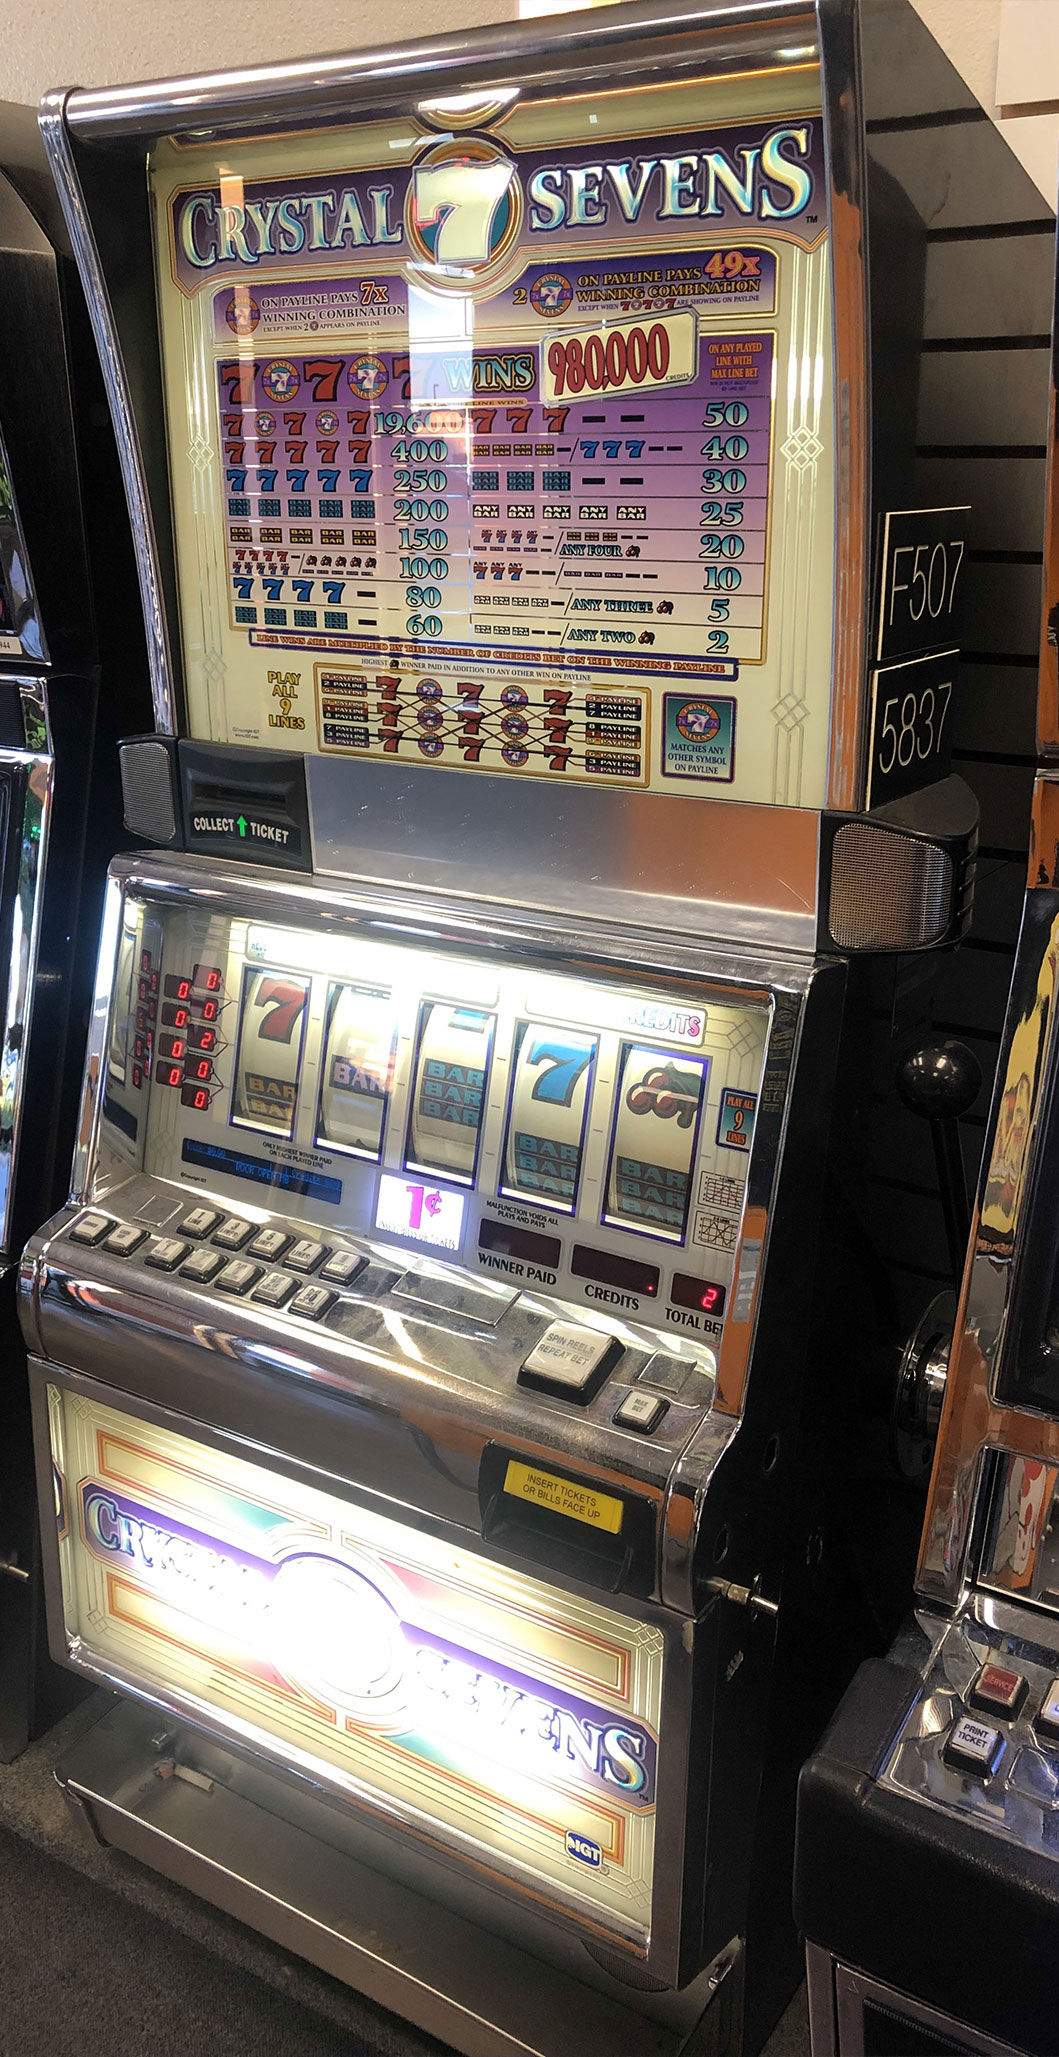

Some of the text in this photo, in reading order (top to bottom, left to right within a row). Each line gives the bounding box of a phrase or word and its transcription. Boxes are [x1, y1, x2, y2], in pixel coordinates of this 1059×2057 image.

[181, 188, 402, 268] CRYSTAL
[531, 129, 810, 230] SEVENS
[512, 288, 527, 305] 2
[578, 274, 600, 287] ON
[604, 271, 662, 285] PAYLINE
[667, 268, 701, 281] PAYS
[577, 280, 760, 302] WINNING COMBINATION
[262, 298, 278, 308] ON
[282, 294, 327, 307] PAYLINE
[331, 292, 358, 303] PAYS
[690, 297, 721, 305] SHOWING
[263, 305, 405, 322] WINNING COMBINATION
[444, 356, 534, 391] WINS
[549, 323, 670, 395] 980,000
[709, 343, 762, 354] ON ANY PLAYED
[716, 356, 752, 365] LINE WITH
[712, 368, 758, 378] MAX LINE BET
[374, 411, 464, 434] 19,600
[703, 402, 749, 427] 50
[391, 440, 448, 462] 400
[701, 436, 749, 460] 40
[393, 470, 447, 492] 250
[701, 469, 746, 494] 30
[393, 499, 448, 521] 200
[700, 502, 744, 526] 25
[399, 528, 448, 550] 150
[699, 534, 744, 559] 20
[561, 544, 622, 557] ANY FOUR
[400, 557, 448, 580] 100
[703, 566, 742, 591] 10
[889, 540, 965, 626] F507
[406, 586, 441, 608] 80
[571, 599, 653, 613] ANY THREE
[707, 599, 730, 622] 5
[406, 614, 442, 637] 60
[567, 629, 636, 644] ANY TWO
[706, 630, 729, 654] 2
[257, 634, 278, 643] LINE
[280, 636, 306, 644] WINS
[307, 638, 326, 646] ARE
[390, 643, 403, 651] BY
[404, 645, 425, 653] THE
[428, 646, 475, 657] NUMBER
[476, 650, 492, 658] OF
[567, 656, 585, 664] ON
[588, 657, 612, 666] THE
[614, 659, 671, 670] WINNING
[673, 662, 725, 673] PAYLINE
[267, 671, 301, 685] PLAY
[361, 658, 388, 666] HIGHEST
[401, 662, 426, 670] WINNER
[452, 665, 485, 673] ADDITION
[512, 669, 534, 678] OTHER
[536, 671, 550, 679] WIN
[564, 673, 591, 681] PAYLINE
[272, 685, 298, 698] ALL
[280, 698, 291, 715] 9
[601, 704, 637, 712] PAYLINE
[268, 714, 305, 730] LINES
[879, 681, 952, 774] 5837
[668, 753, 727, 765] OTHER SYMBOL
[671, 743, 724, 755] MATCHES ANY
[688, 765, 718, 774] PAYLINE
[193, 817, 289, 844] COLLECT TICKET
[200, 1032, 213, 1048] 2
[427, 1061, 484, 1087] BAR
[726, 1095, 754, 1110] PLAY ALL
[733, 1110, 744, 1131] 9
[519, 1134, 578, 1161] BAR
[726, 1131, 746, 1145] LINES
[263, 1141, 332, 1165] ONLY HIGHEST WINNER PAID
[621, 1159, 686, 1189] BAR
[187, 1217, 202, 1225] LINE
[486, 1200, 559, 1226] MALFUNCTION VOIDS ALL
[498, 1210, 546, 1229] PLAYS AND PAYS
[622, 1199, 683, 1225] BAR
[291, 1250, 310, 1259] LINES
[478, 1252, 557, 1286] WINNER PAID
[584, 1284, 640, 1311] CREDITS
[701, 1288, 717, 1309] 2
[665, 1308, 701, 1331] TOTAL
[547, 1333, 595, 1354] SPIN REELS
[538, 1344, 590, 1366] REPEAT BET
[631, 1405, 644, 1413] BET
[634, 1398, 649, 1407] MAX
[523, 1484, 600, 1519] OR BILLS FACE UP
[527, 1474, 597, 1507] INSERT TICKETS
[984, 1672, 1014, 1693] SERVICE
[958, 1730, 988, 1749] TICKET
[963, 1723, 989, 1739] PRINT
